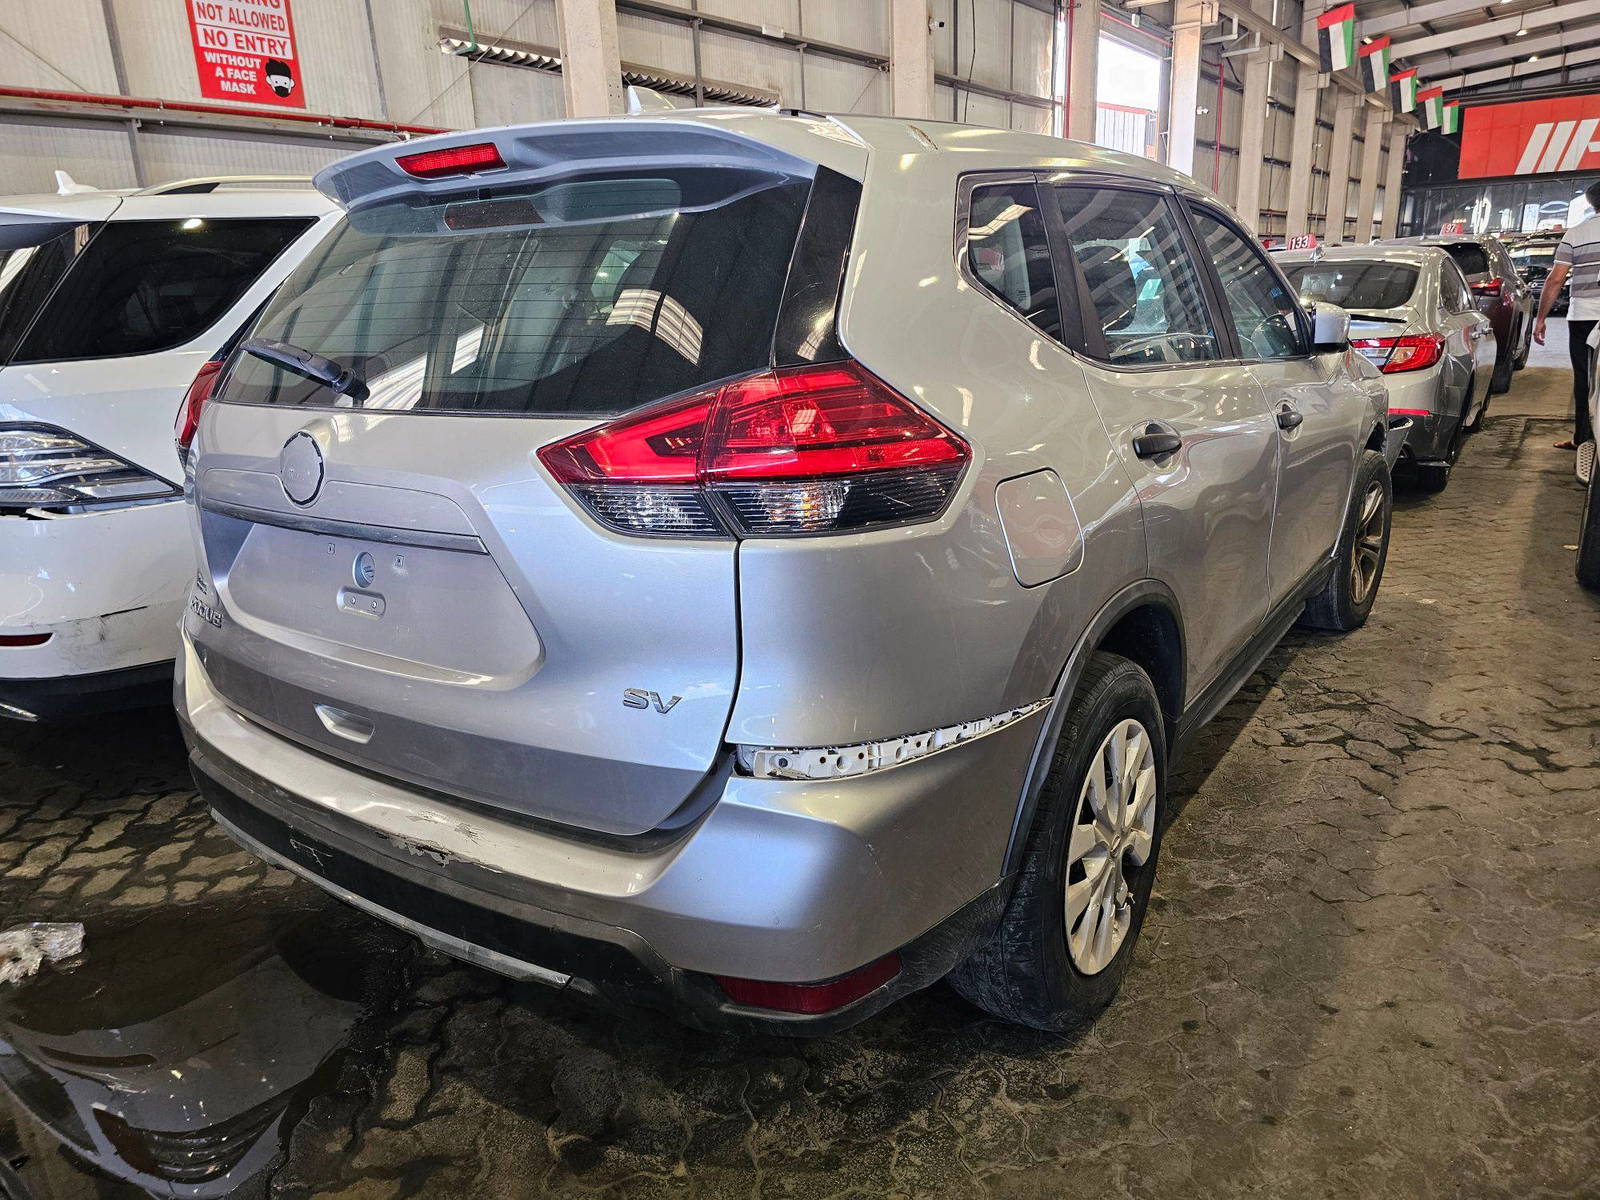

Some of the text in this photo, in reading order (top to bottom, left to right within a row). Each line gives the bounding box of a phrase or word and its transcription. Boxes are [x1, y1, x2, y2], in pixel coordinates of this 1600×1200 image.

[197, 2, 222, 21] NOT
[229, 8, 285, 31] ALLOWED
[203, 28, 287, 56] NO ENTRY
[204, 51, 261, 69] WITHOUT
[216, 67, 256, 81] A FACE
[221, 81, 256, 94] MASK
[1291, 235, 1309, 250] 133
[622, 688, 683, 714] SV
